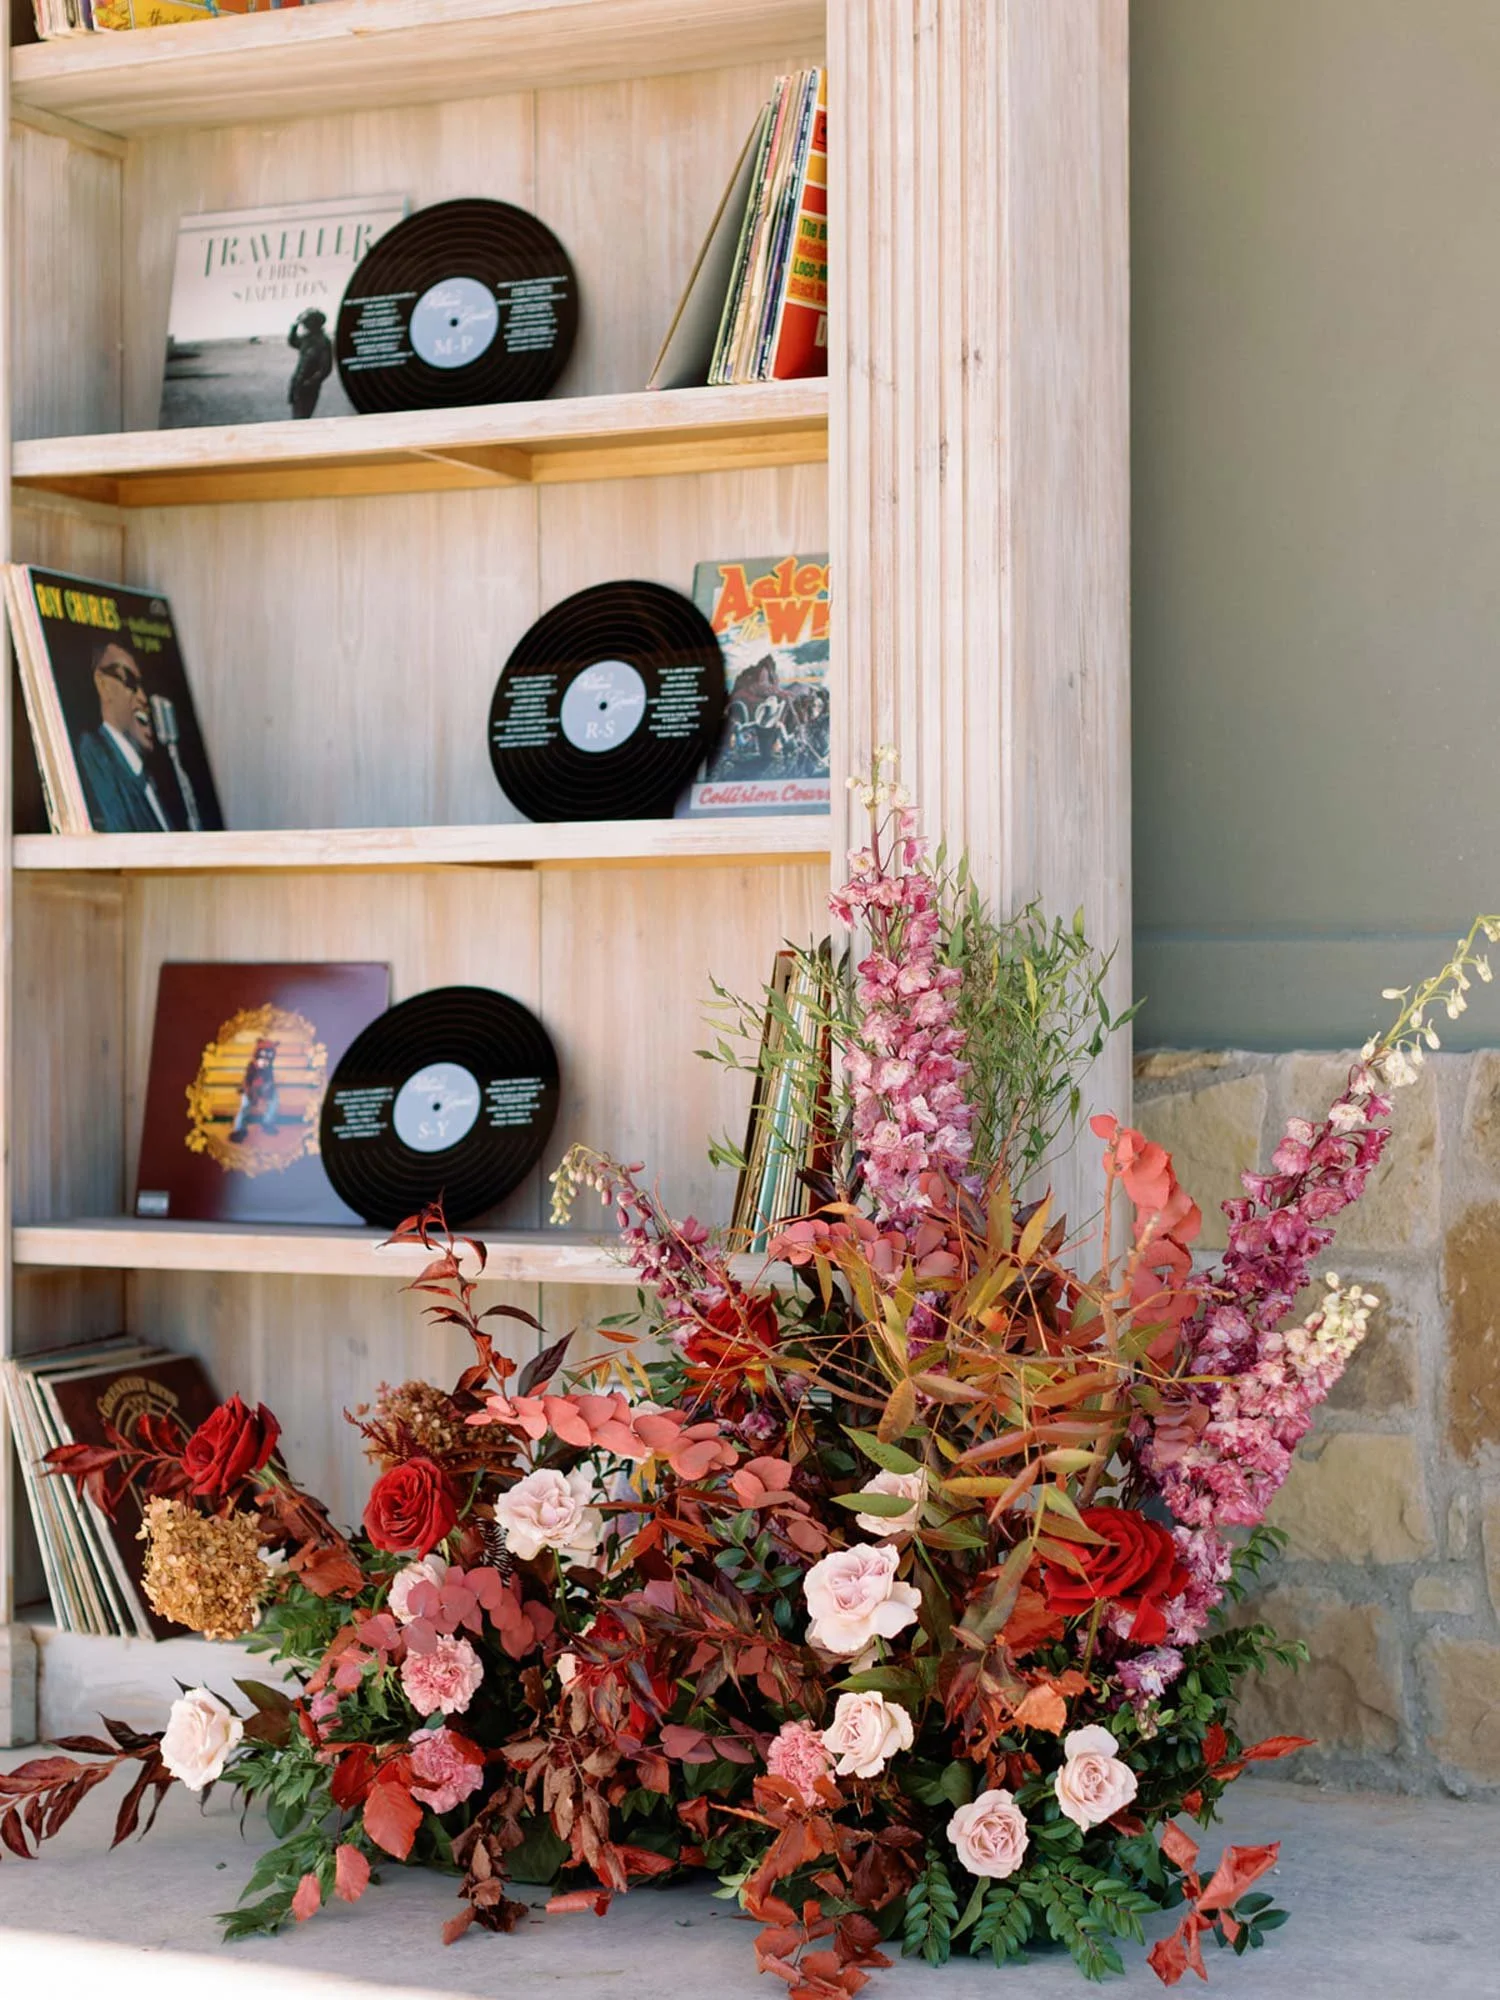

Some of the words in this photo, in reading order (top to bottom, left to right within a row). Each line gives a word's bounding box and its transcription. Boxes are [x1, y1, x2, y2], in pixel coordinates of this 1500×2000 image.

[201, 224, 372, 277] TRAVELLER
[256, 261, 308, 281] CHRIS
[64, 588, 121, 632] CHARLES
[699, 785, 779, 805] Collision
